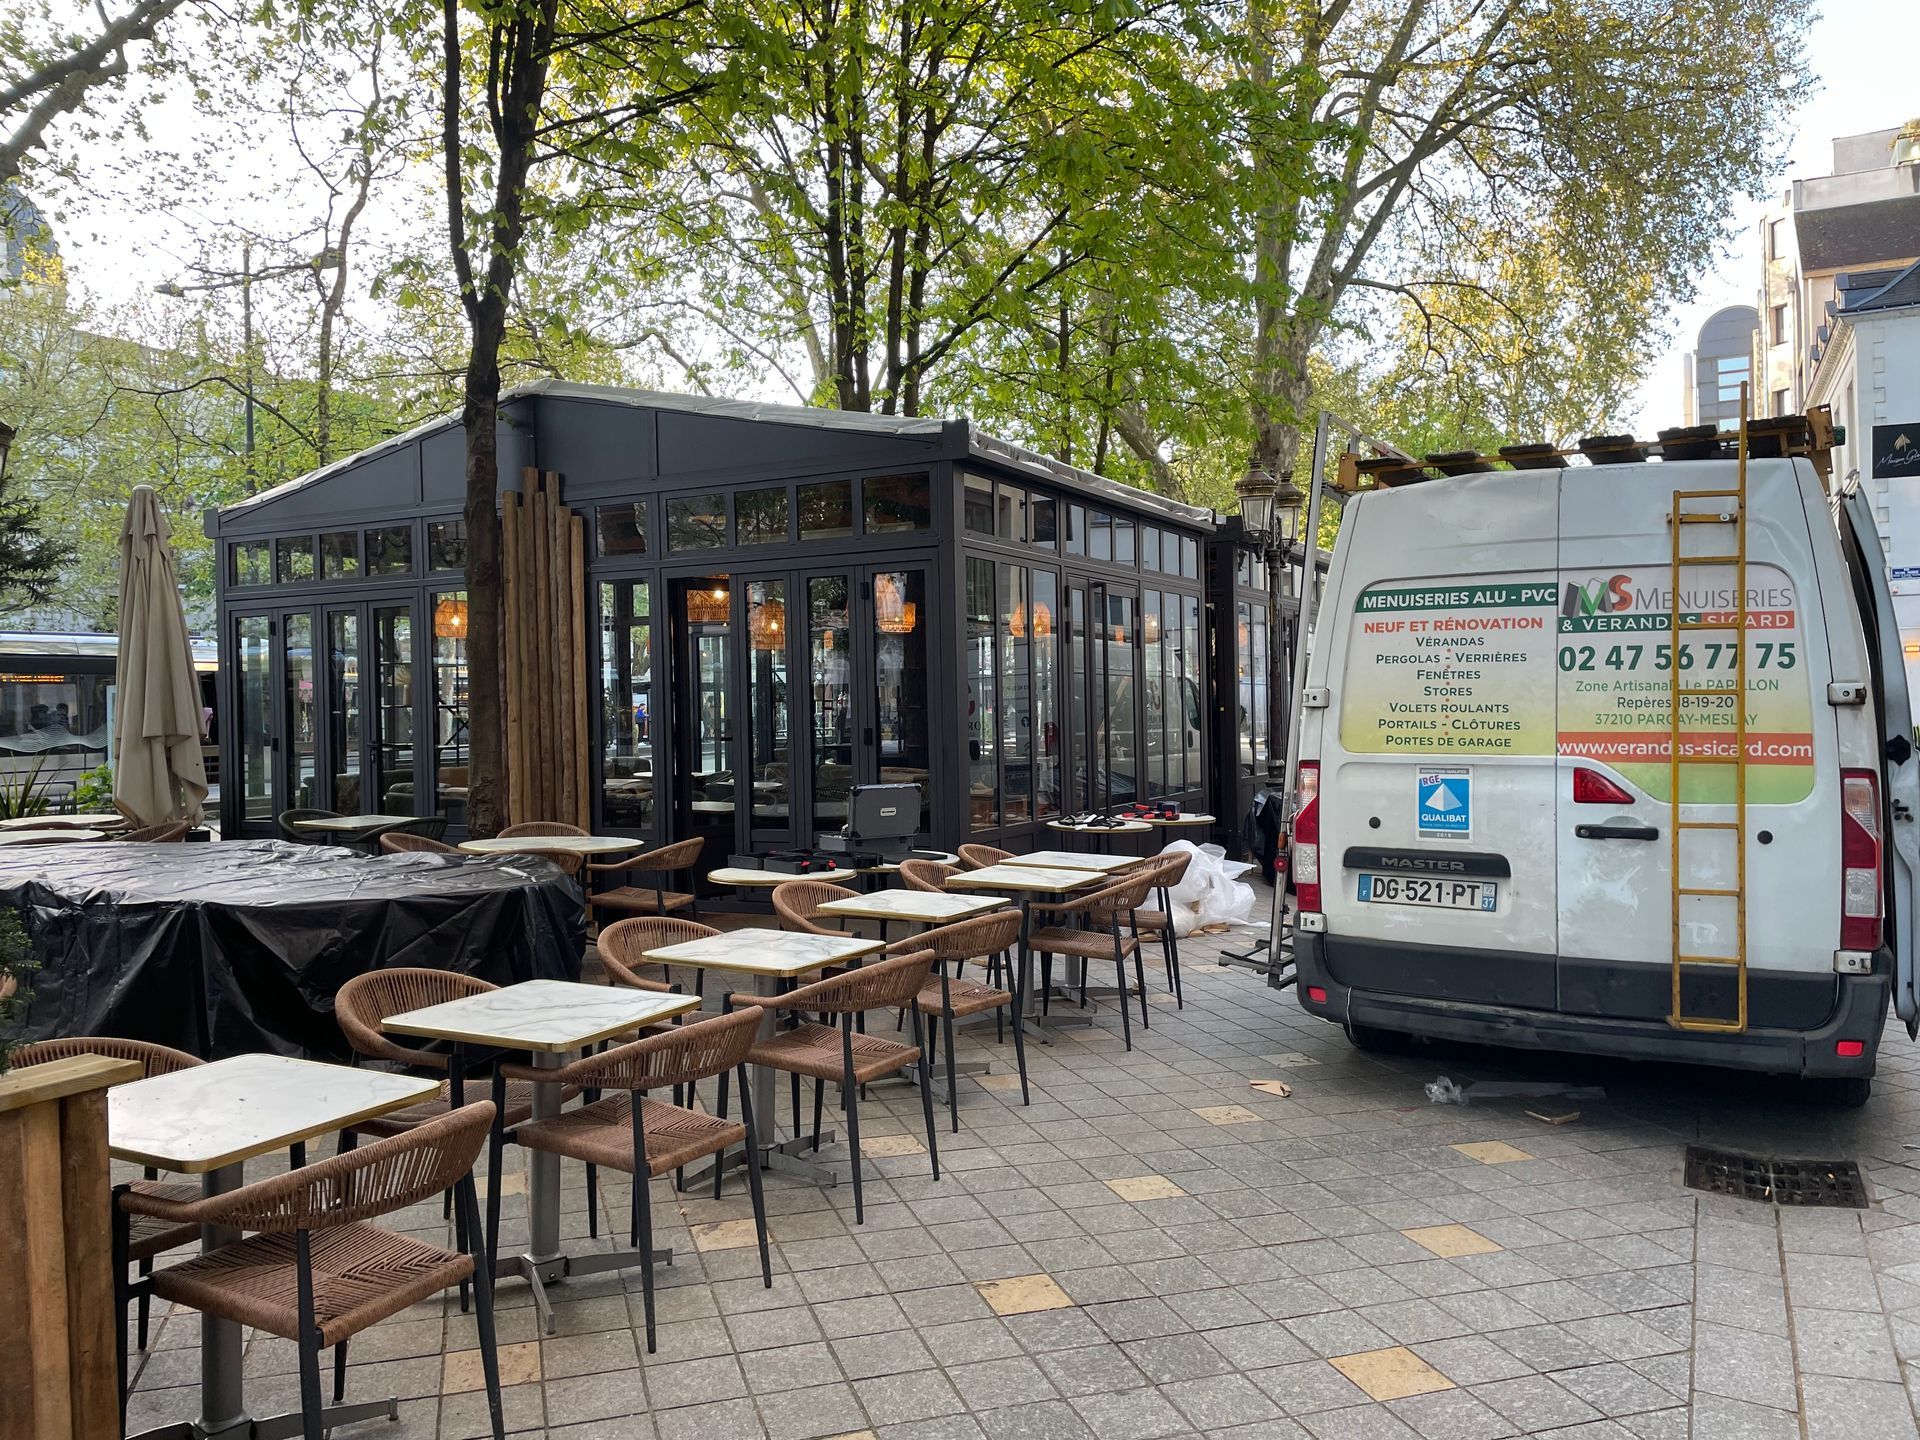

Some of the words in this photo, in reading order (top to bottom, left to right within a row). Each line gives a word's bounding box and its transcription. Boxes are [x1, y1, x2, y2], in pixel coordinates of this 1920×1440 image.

[1362, 591, 1470, 609] MENUISERIES
[1472, 590, 1507, 605] ALU
[1521, 588, 1557, 602] PVC
[1364, 621, 1406, 634] NEUF
[1409, 620, 1429, 632] ET
[1433, 617, 1543, 632] RÉNOVATION
[1562, 619, 1573, 631] &
[1582, 616, 1697, 631] VERANDS
[1559, 645, 1596, 671] 02
[1605, 645, 1643, 671] 47
[1654, 644, 1694, 671] 56
[1704, 643, 1740, 669] 77
[1755, 643, 1796, 669] 75
[1576, 681, 1609, 692] Zone
[1613, 680, 1680, 692] Artisanal
[1707, 679, 1779, 691] PAPILON
[1441, 704, 1510, 714] ROULANTS
[1617, 696, 1672, 710] Repères
[1595, 713, 1633, 725] 37210
[1437, 737, 1454, 747] DE
[1458, 737, 1512, 748] GARAGE
[1423, 775, 1440, 786] RGE
[1421, 813, 1467, 823] QUALIBAT
[1381, 857, 1465, 871] MASTER
[1373, 877, 1480, 906] DG-521-PT
[1482, 897, 1495, 909] 37
